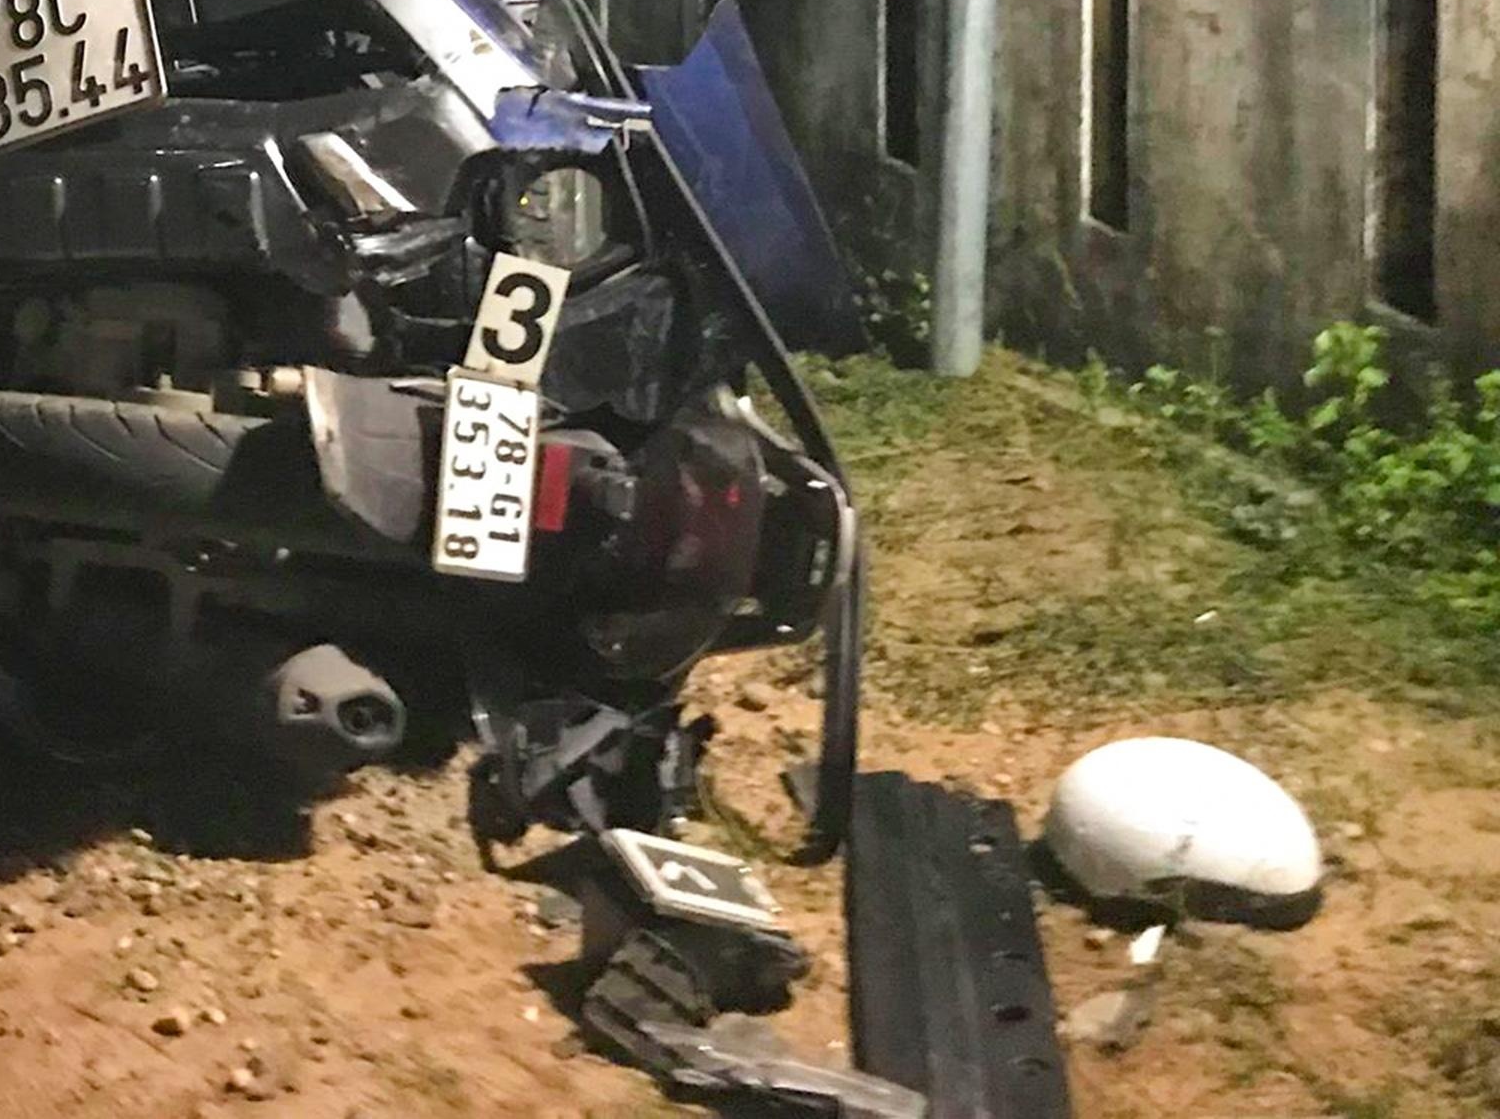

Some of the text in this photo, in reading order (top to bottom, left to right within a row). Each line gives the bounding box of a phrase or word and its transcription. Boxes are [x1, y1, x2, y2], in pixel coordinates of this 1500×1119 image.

[481, 272, 552, 365] 3
[443, 384, 492, 561] 353.18
[488, 411, 532, 545] 78-G1
